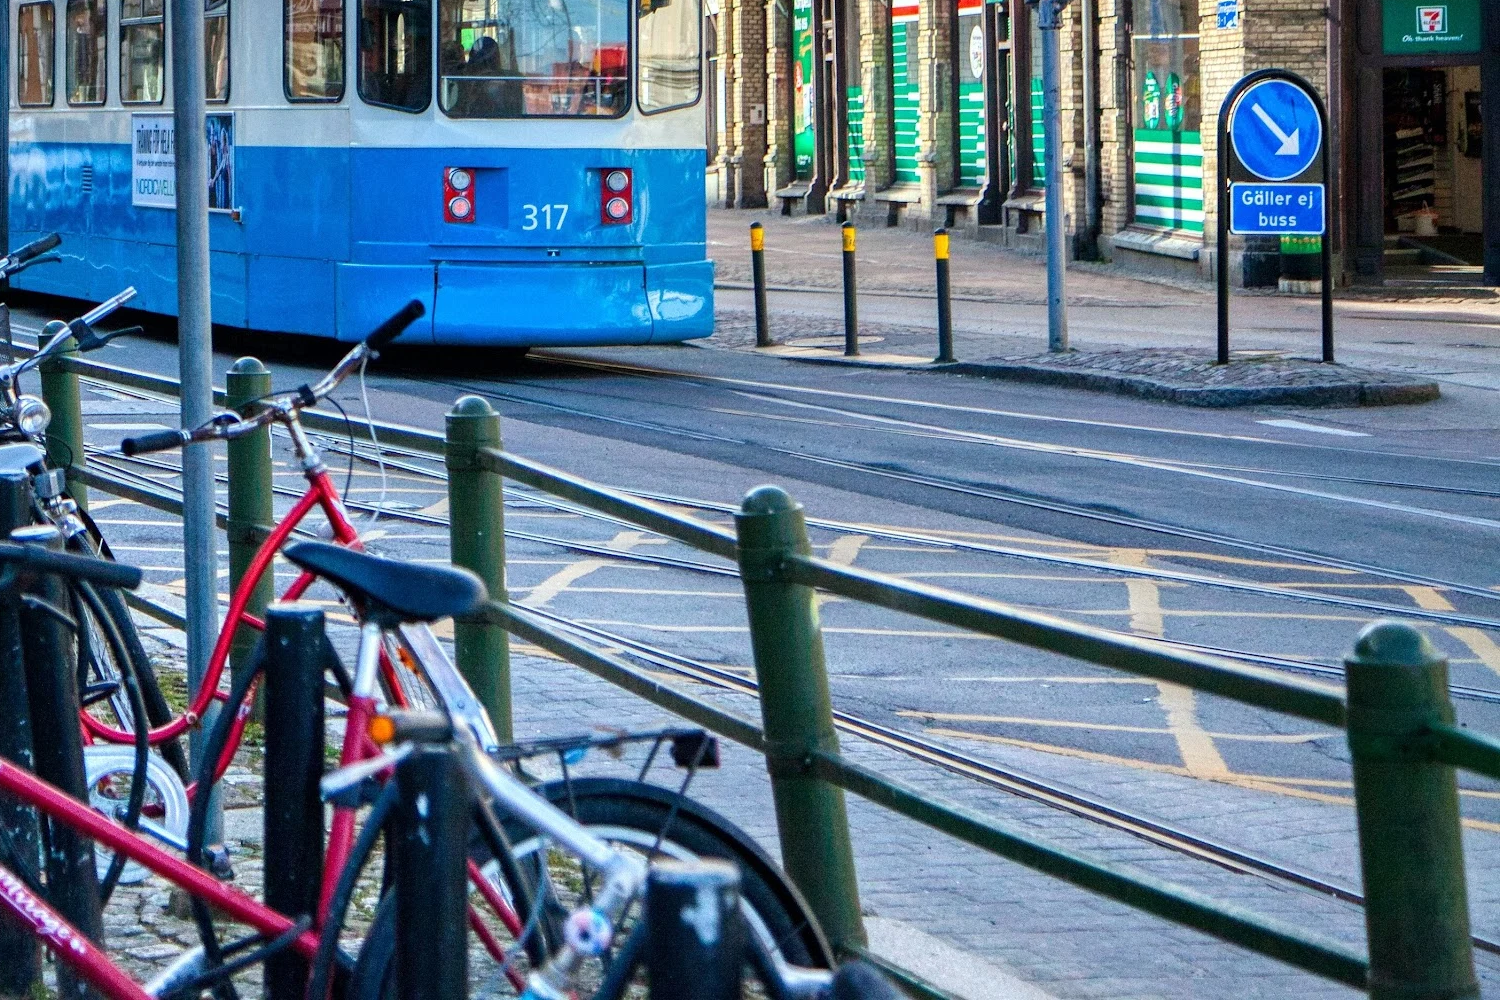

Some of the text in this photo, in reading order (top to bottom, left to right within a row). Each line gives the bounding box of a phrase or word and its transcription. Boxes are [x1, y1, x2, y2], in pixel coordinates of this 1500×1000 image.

[1415, 34, 1435, 42] thank
[136, 178, 175, 197] NORDICWELL
[1242, 190, 1314, 209] Gäller ej
[522, 204, 569, 231] 317
[1258, 212, 1297, 227] buss
